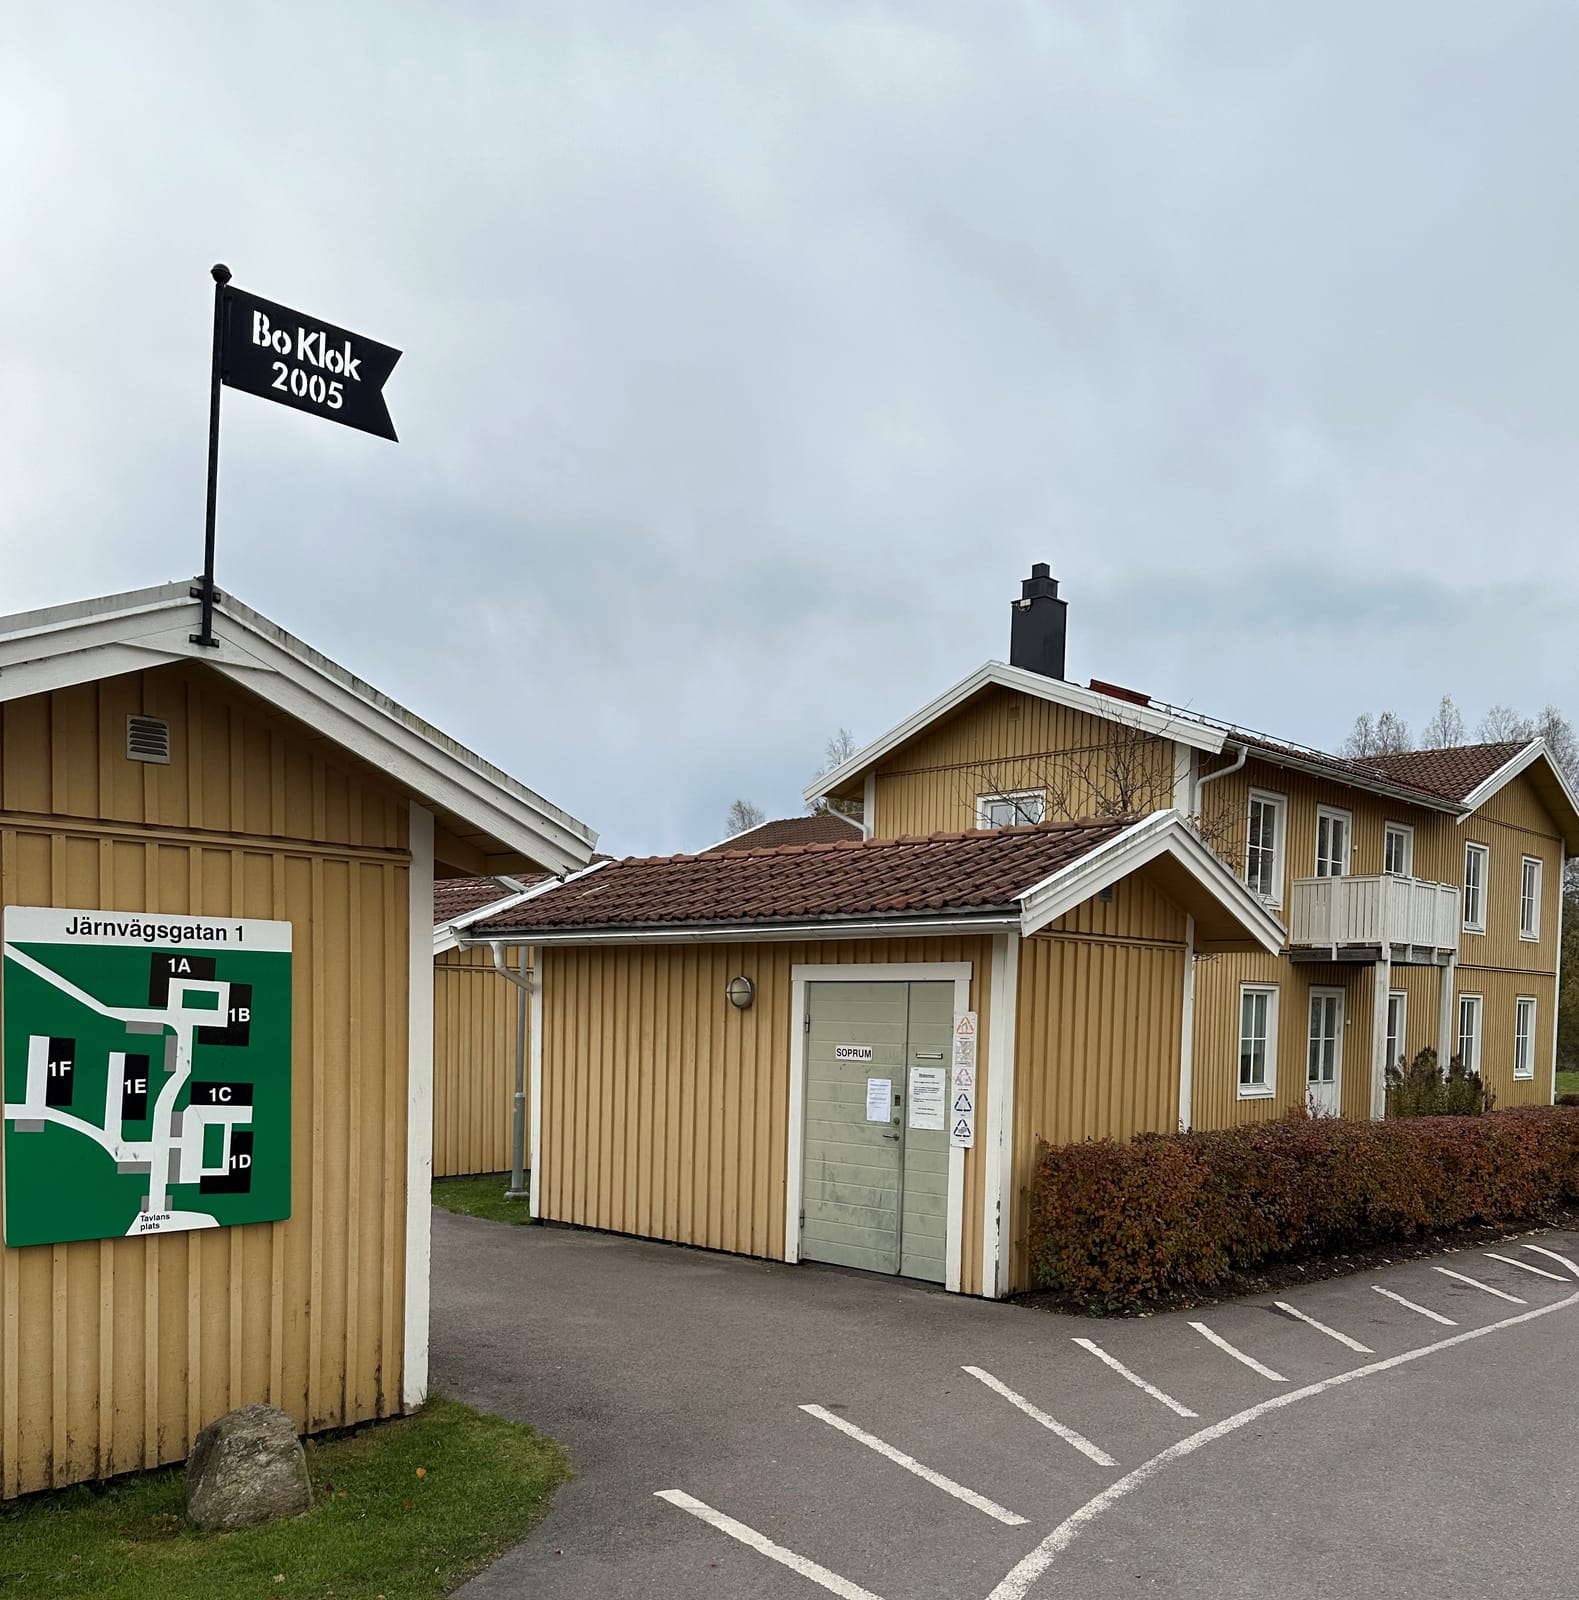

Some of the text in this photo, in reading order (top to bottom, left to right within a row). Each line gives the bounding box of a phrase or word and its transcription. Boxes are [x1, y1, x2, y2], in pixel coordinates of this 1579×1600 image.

[252, 309, 362, 382] Bo Klok
[271, 361, 343, 409] 2005
[65, 916, 243, 943] Järnvägsgatan 1
[167, 958, 191, 973] 1A
[228, 1008, 250, 1022] 1B
[836, 1048, 871, 1058] SOPRUM
[49, 1061, 72, 1077] 1F
[124, 1079, 147, 1094] 1E
[209, 1087, 232, 1102] 1C
[229, 1154, 251, 1168] 1D
[140, 1213, 170, 1222] Tavlans
[140, 1222, 160, 1232] plats
